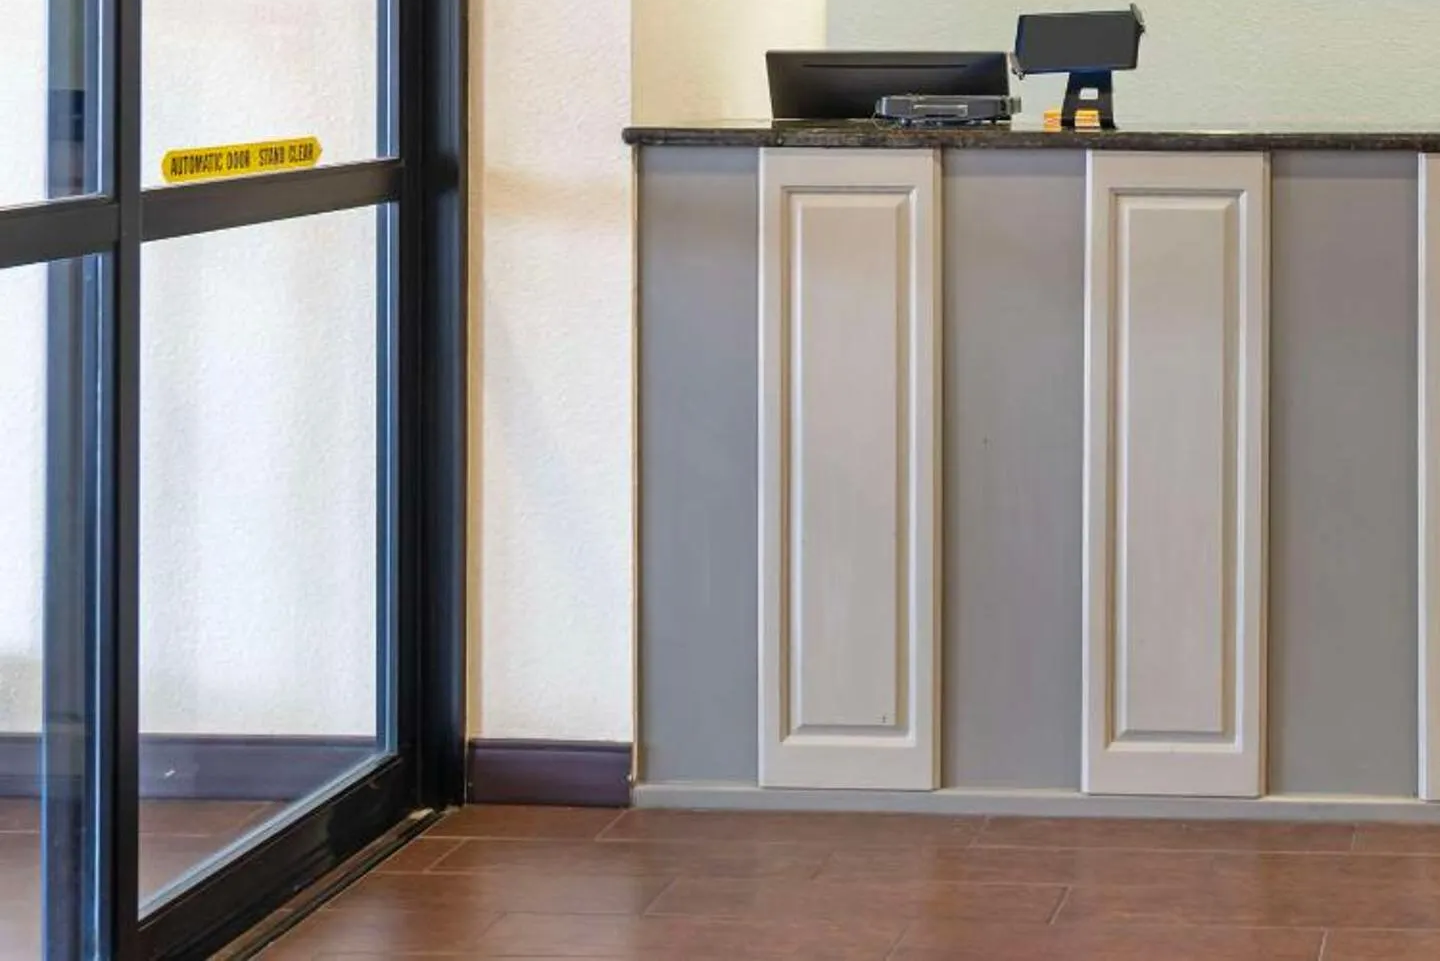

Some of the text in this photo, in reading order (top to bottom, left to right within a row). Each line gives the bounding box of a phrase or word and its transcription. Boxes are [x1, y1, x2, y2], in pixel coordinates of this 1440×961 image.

[171, 153, 223, 176] AUTOMATIC
[259, 145, 285, 167] STAND
[288, 142, 314, 163] CLEAR
